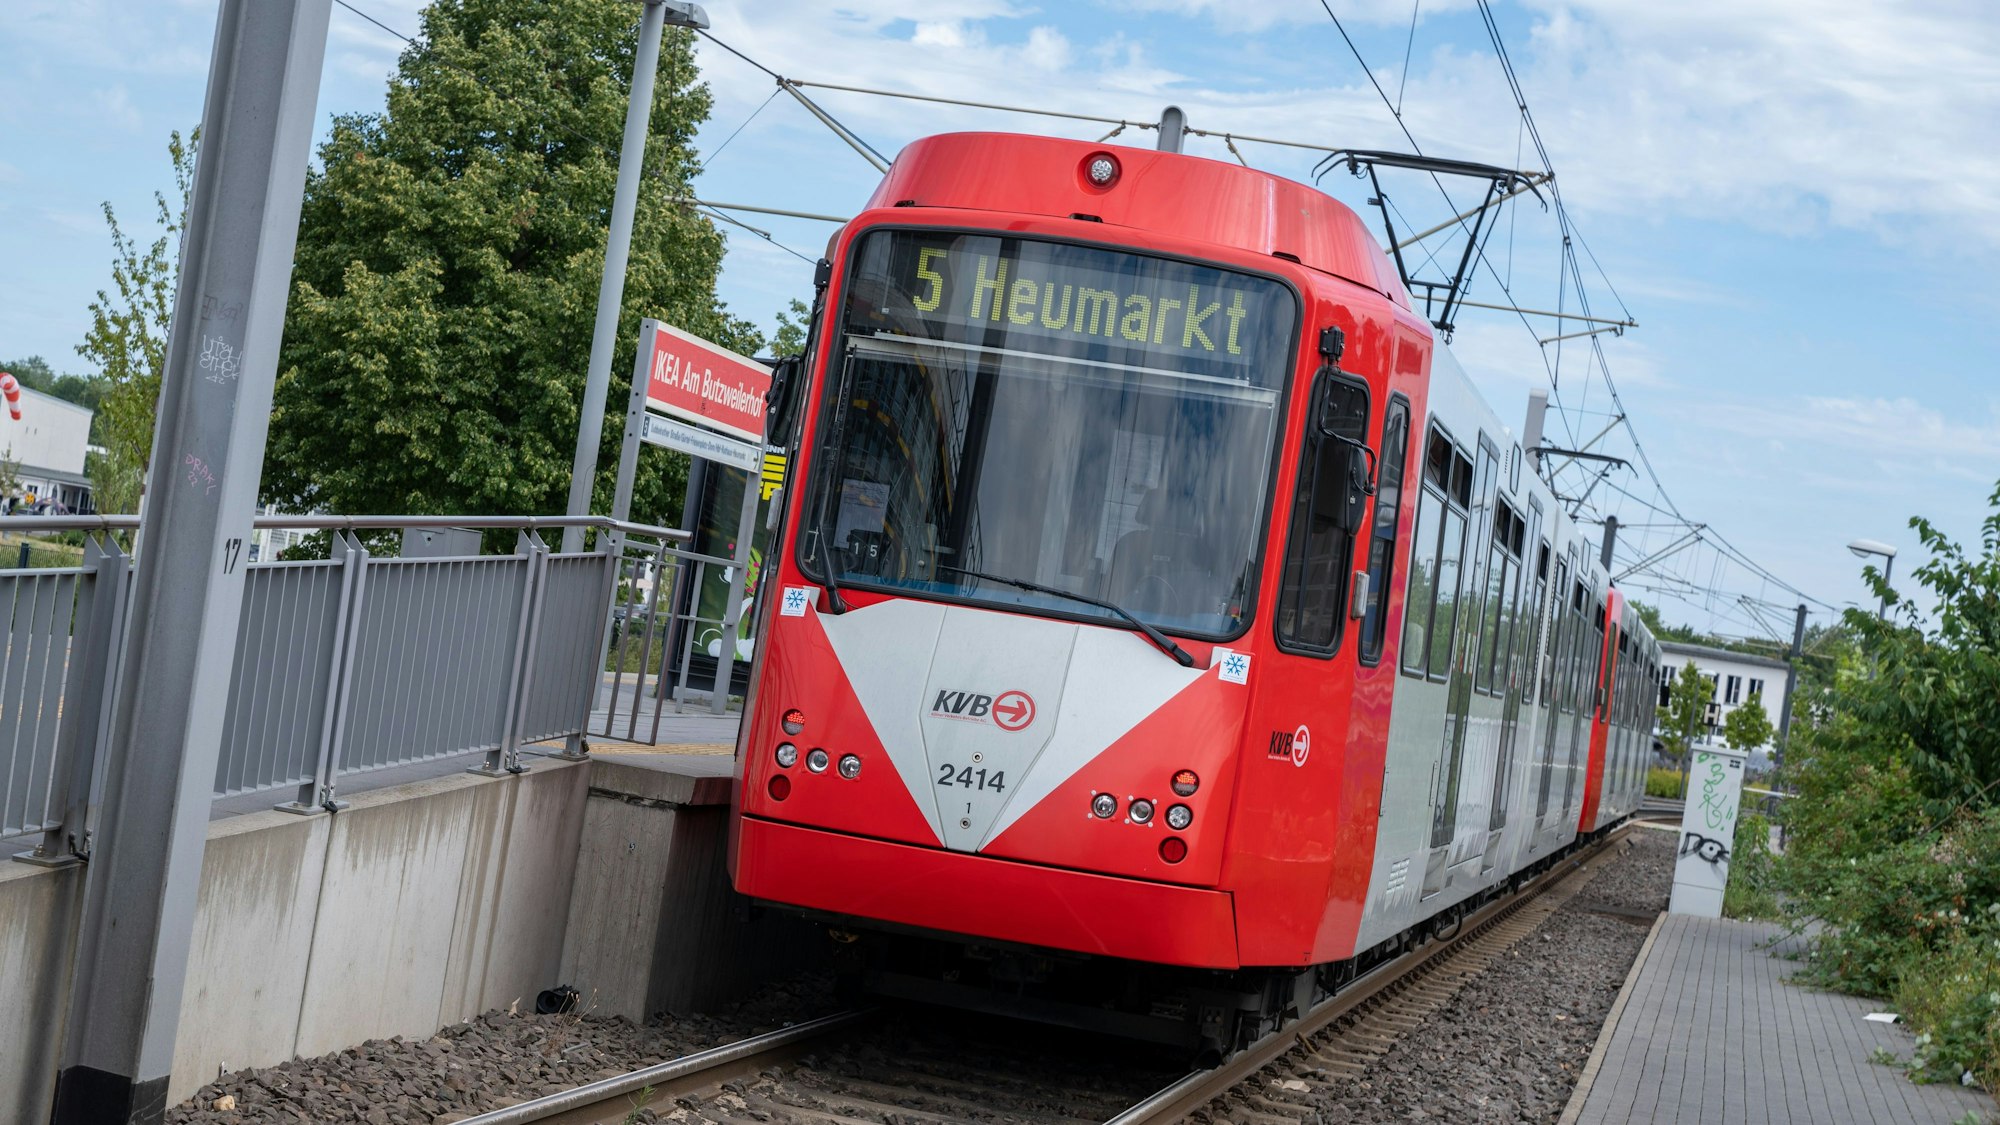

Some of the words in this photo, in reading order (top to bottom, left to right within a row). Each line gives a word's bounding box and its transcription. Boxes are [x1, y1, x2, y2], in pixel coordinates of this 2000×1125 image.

[912, 246, 947, 312] 5
[970, 255, 1247, 355] Heumarkt
[653, 349, 680, 387] IKEA
[681, 361, 701, 395] Am
[701, 369, 764, 417] Butzweilerhof
[223, 538, 242, 575] 17
[932, 690, 992, 717] KVB
[1703, 703, 1720, 726] H
[1269, 731, 1294, 755] KVB
[937, 763, 1005, 793] 2414
[966, 802, 971, 814] 1
